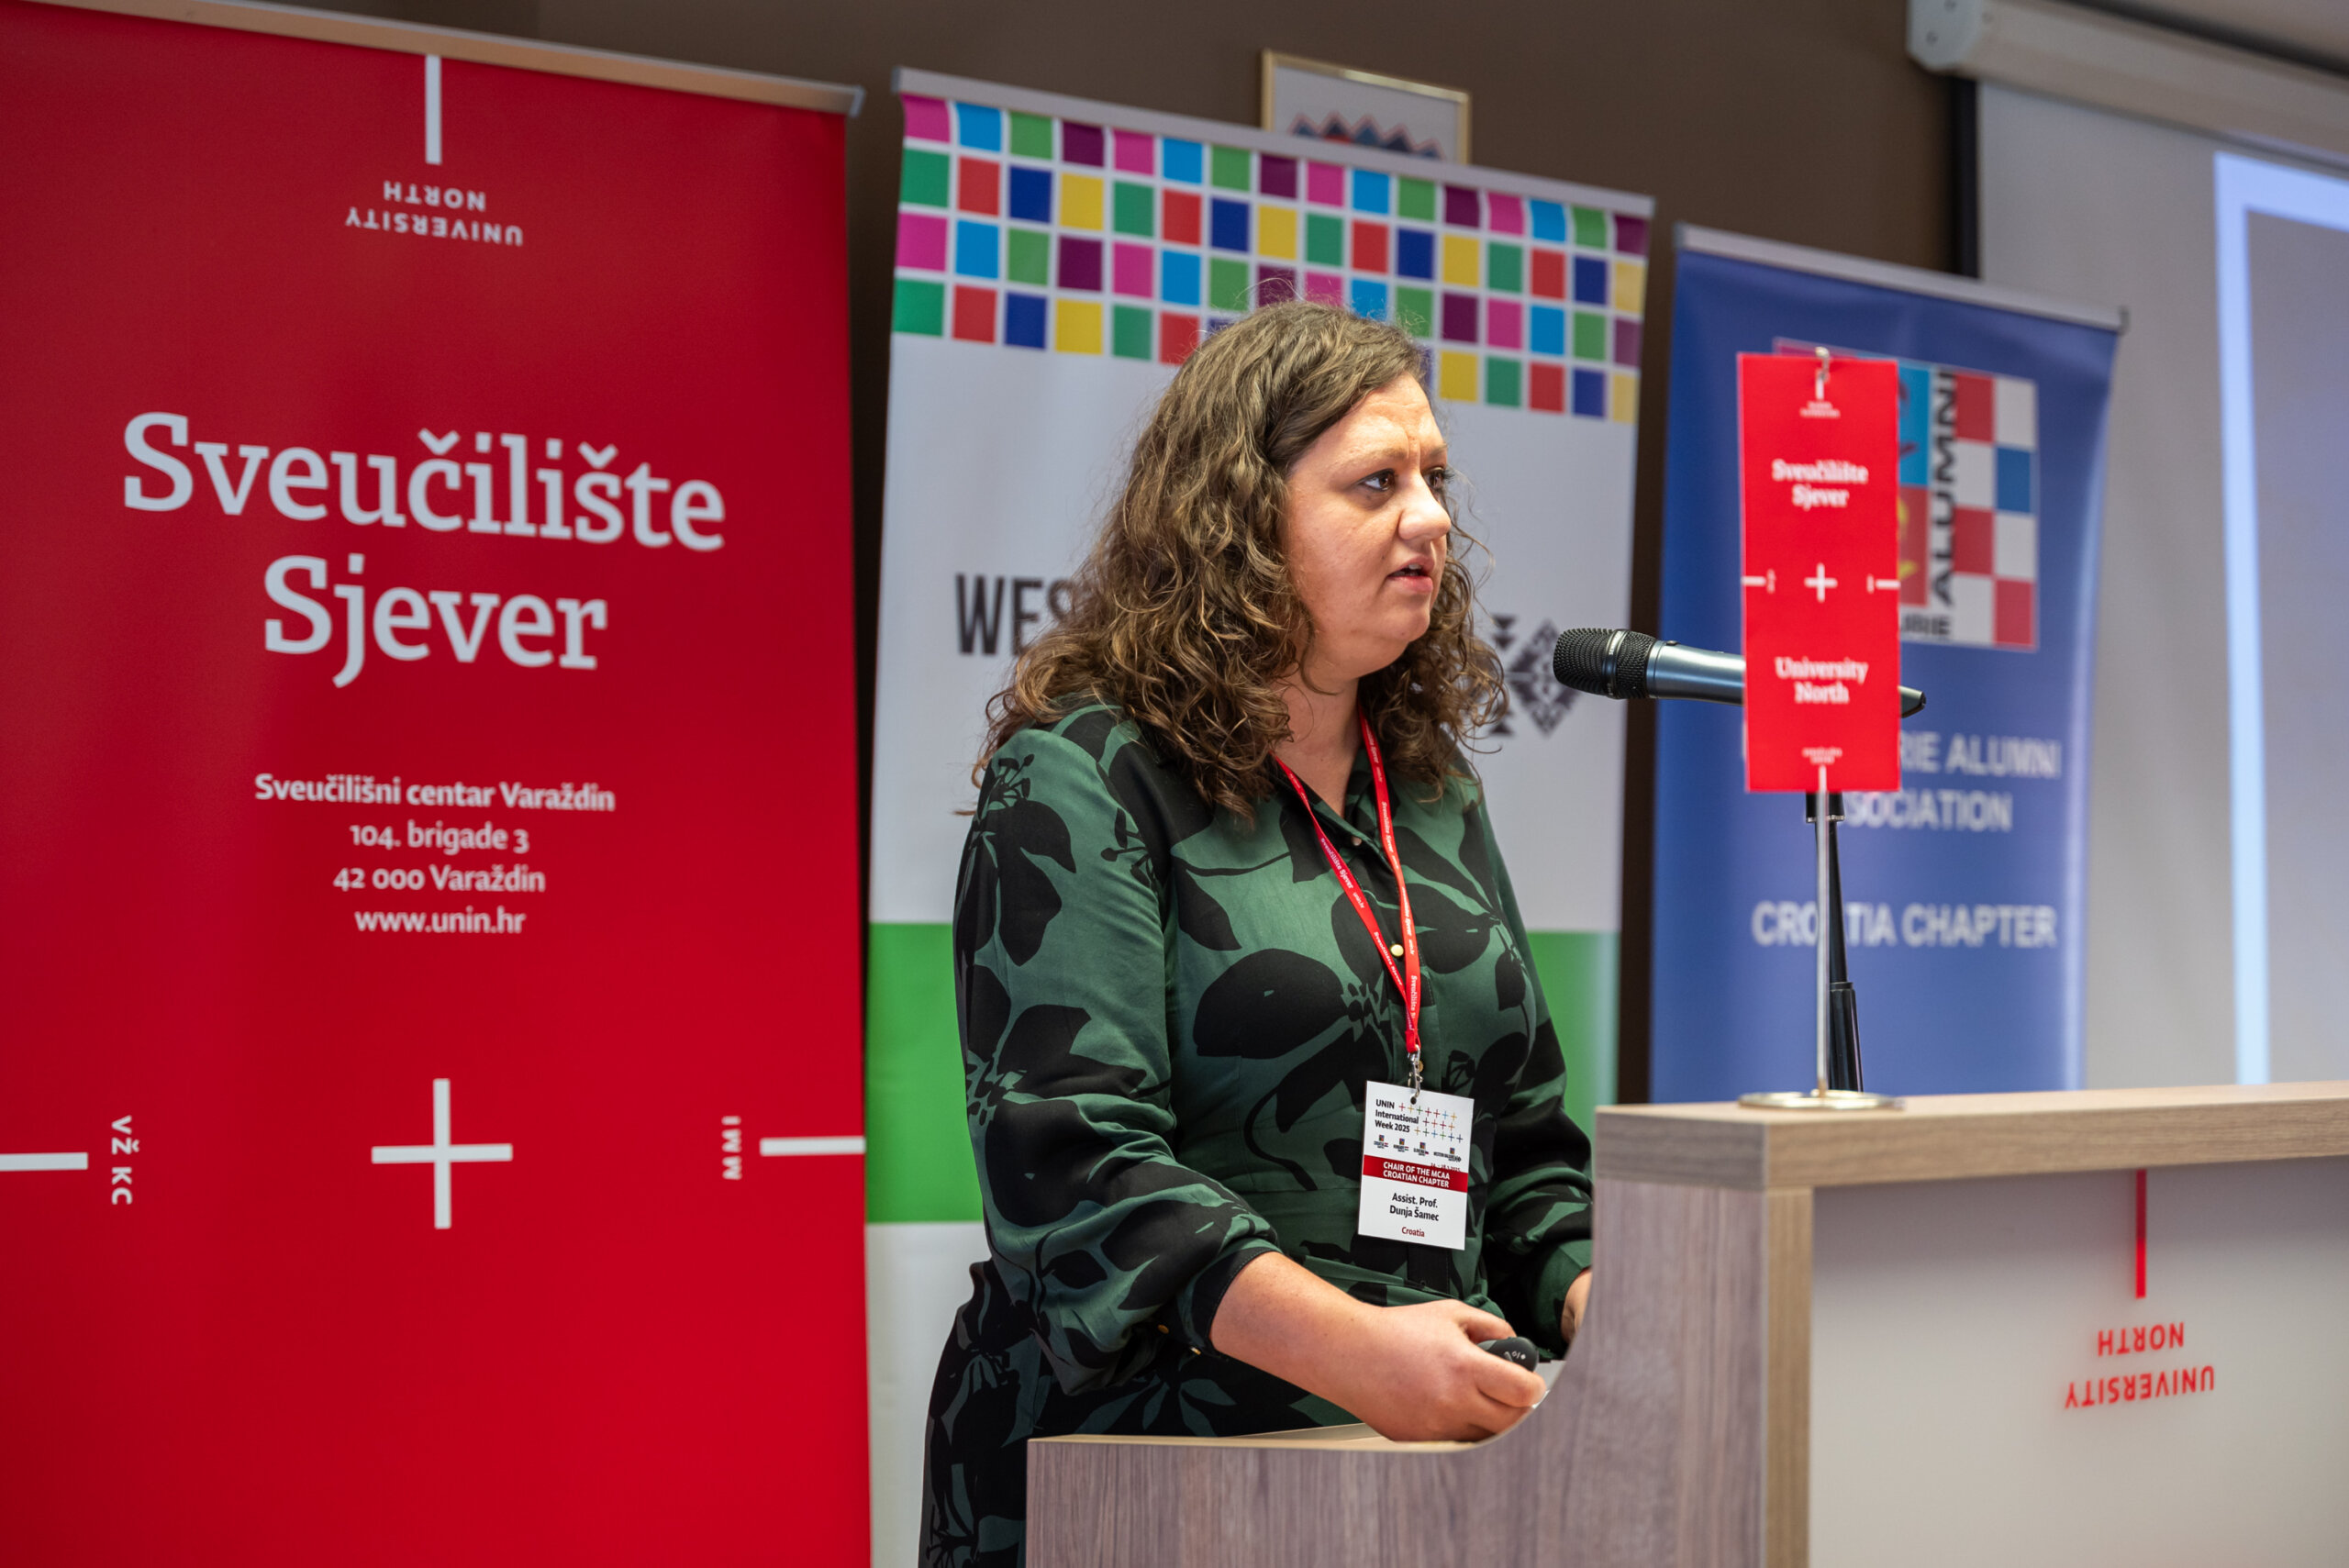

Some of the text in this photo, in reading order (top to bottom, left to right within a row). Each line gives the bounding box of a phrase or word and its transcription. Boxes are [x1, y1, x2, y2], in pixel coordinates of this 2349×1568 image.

[383, 181, 486, 212] NORTH
[345, 206, 523, 247] UNIVERSITY
[124, 411, 725, 551] Sveučilište
[1932, 369, 1956, 606] ALUMNI
[263, 552, 607, 688] Sjever
[1775, 655, 1869, 685] University
[1794, 681, 1850, 705] North
[1944, 733, 2063, 779] ALUMNI
[254, 773, 616, 812] Sveučilišni centar Varaždin
[1843, 792, 2013, 833] SOCIATION
[349, 819, 530, 856] 104. brigade 3
[332, 863, 546, 893] 42 000 Varaždin
[354, 905, 527, 934] www.unin.hr
[1752, 900, 2058, 949] CROTIA CHAPTER
[1375, 1099, 1395, 1109] UNIN
[1375, 1109, 1419, 1124] International
[1375, 1119, 1410, 1132] Week 2025
[111, 1166, 133, 1206] KC
[1383, 1162, 1404, 1173] CHAIR
[1406, 1164, 1416, 1173] OF
[1417, 1167, 1430, 1175] THE
[1431, 1170, 1450, 1180] MCAA
[1383, 1170, 1450, 1188] CROATIAN CHAPTER
[1390, 1205, 1440, 1221] Dunja Šamec
[1392, 1193, 1438, 1208] Assist. Prof.
[1401, 1227, 1425, 1238] Croatia
[2098, 1322, 2184, 1357] NORTH
[2065, 1365, 2214, 1409] UNIVERSITY
